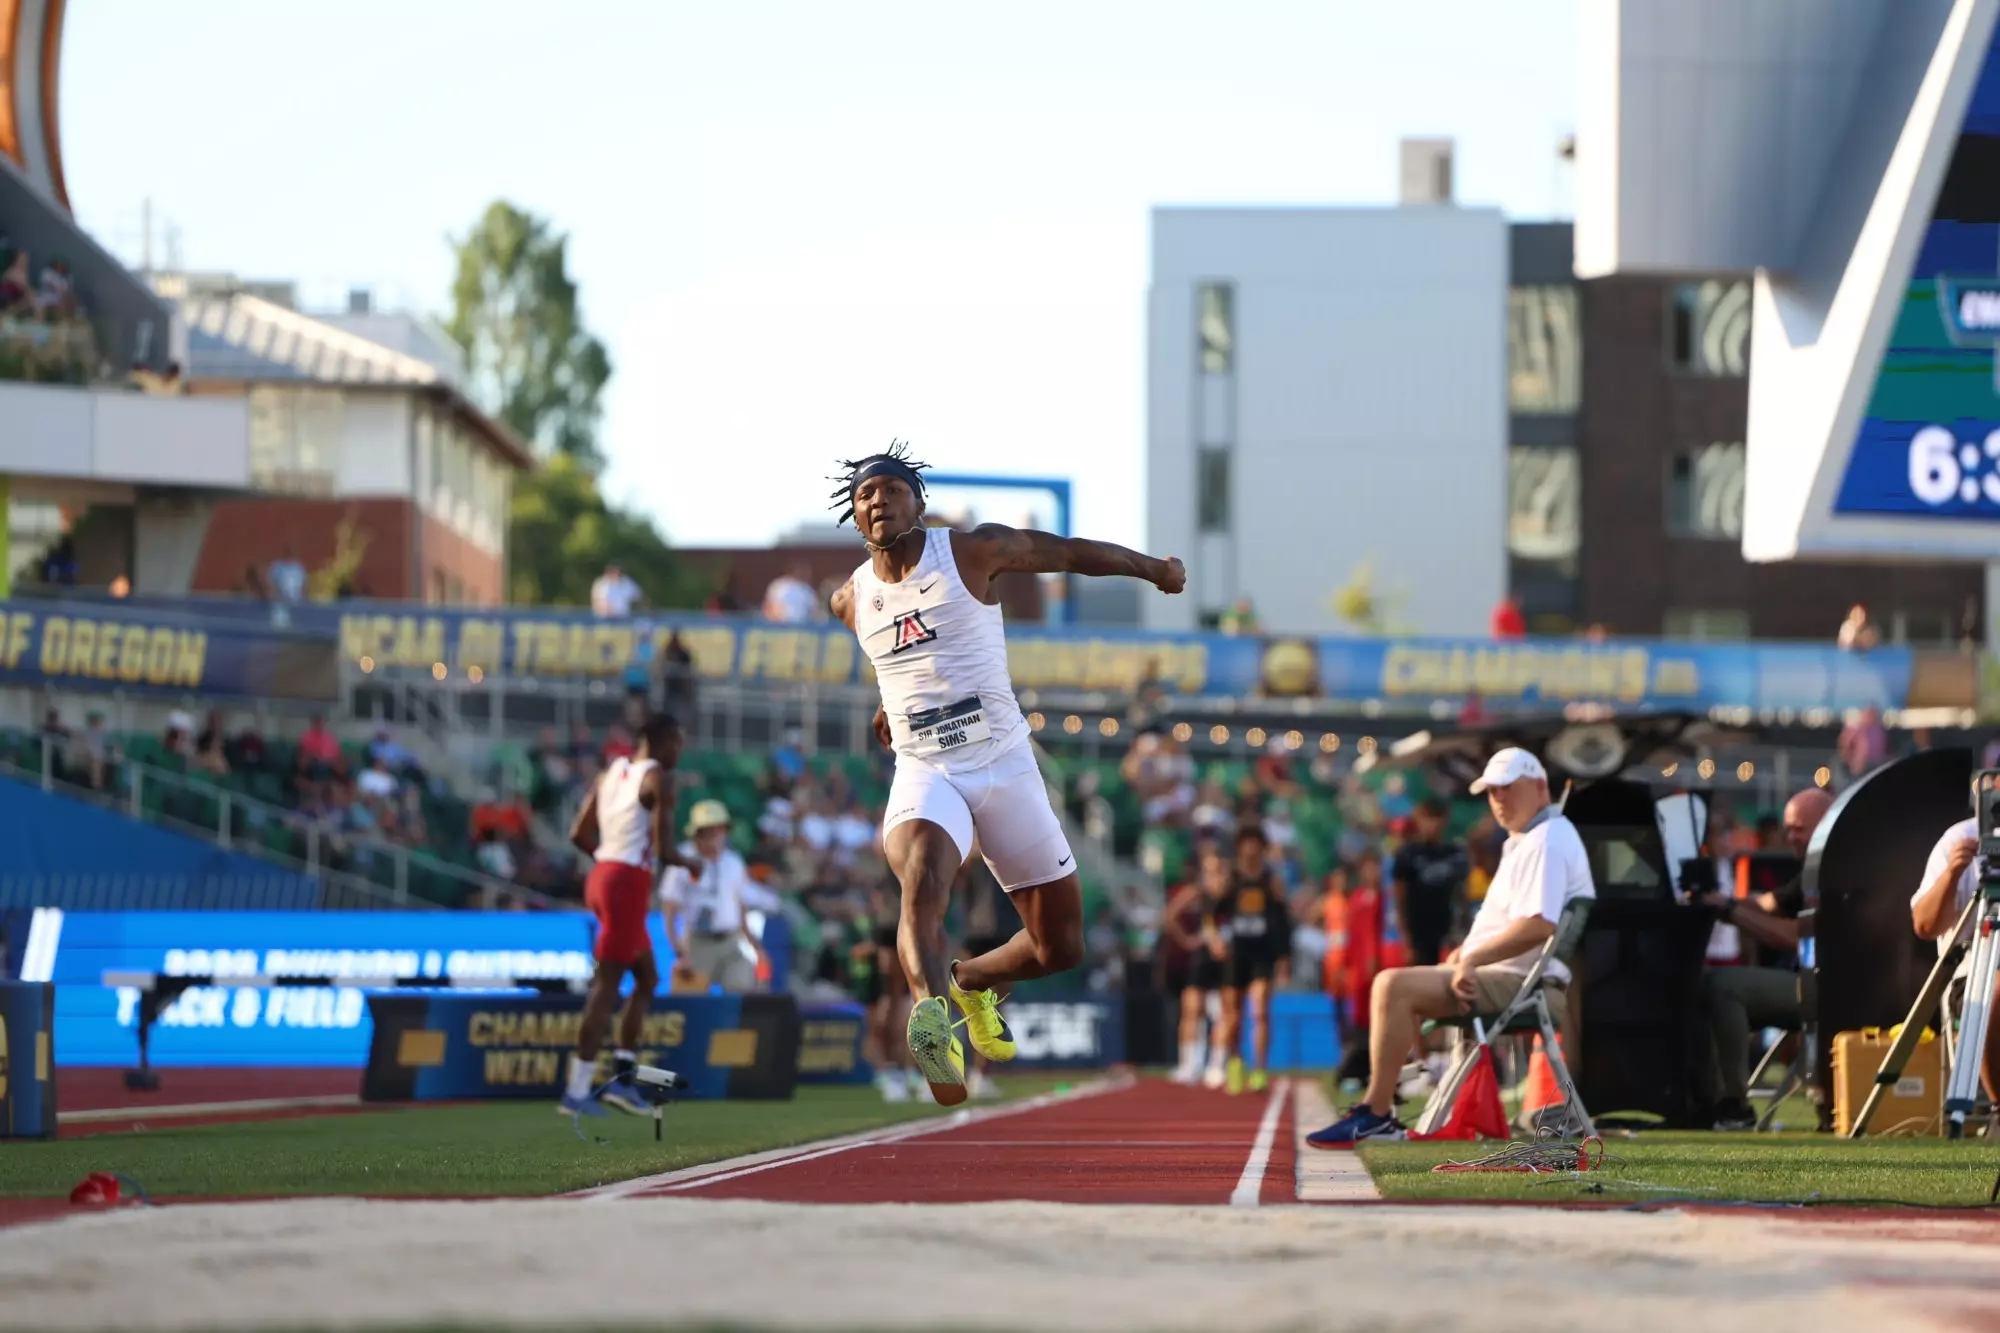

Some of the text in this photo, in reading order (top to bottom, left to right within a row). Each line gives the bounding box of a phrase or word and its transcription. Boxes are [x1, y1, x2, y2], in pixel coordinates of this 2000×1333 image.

[892, 608, 938, 655] A
[42, 615, 207, 687] OREGON
[918, 729, 933, 741] SIR
[936, 713, 981, 736] JONATHAN
[938, 730, 968, 749] SIMS
[115, 986, 229, 1028] TCK
[264, 986, 364, 1028] FIELD
[468, 1010, 686, 1047] CHAMNS
[484, 1050, 559, 1085] WIN
